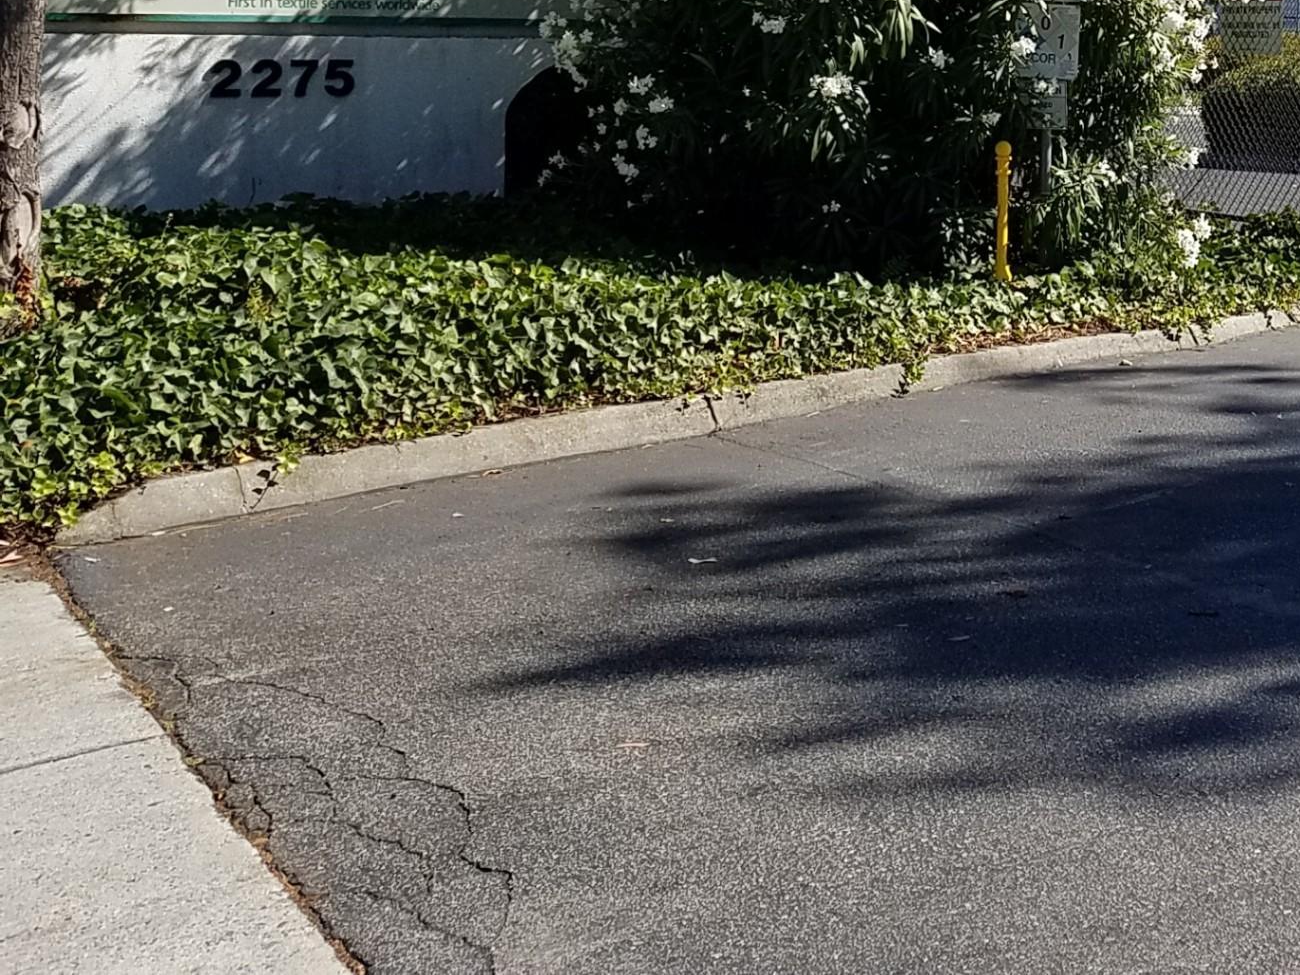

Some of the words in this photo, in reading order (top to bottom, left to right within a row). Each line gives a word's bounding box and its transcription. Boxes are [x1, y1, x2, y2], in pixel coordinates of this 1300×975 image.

[1041, 16, 1051, 31] 0
[1058, 34, 1065, 49] 1
[209, 59, 356, 99] 2275
